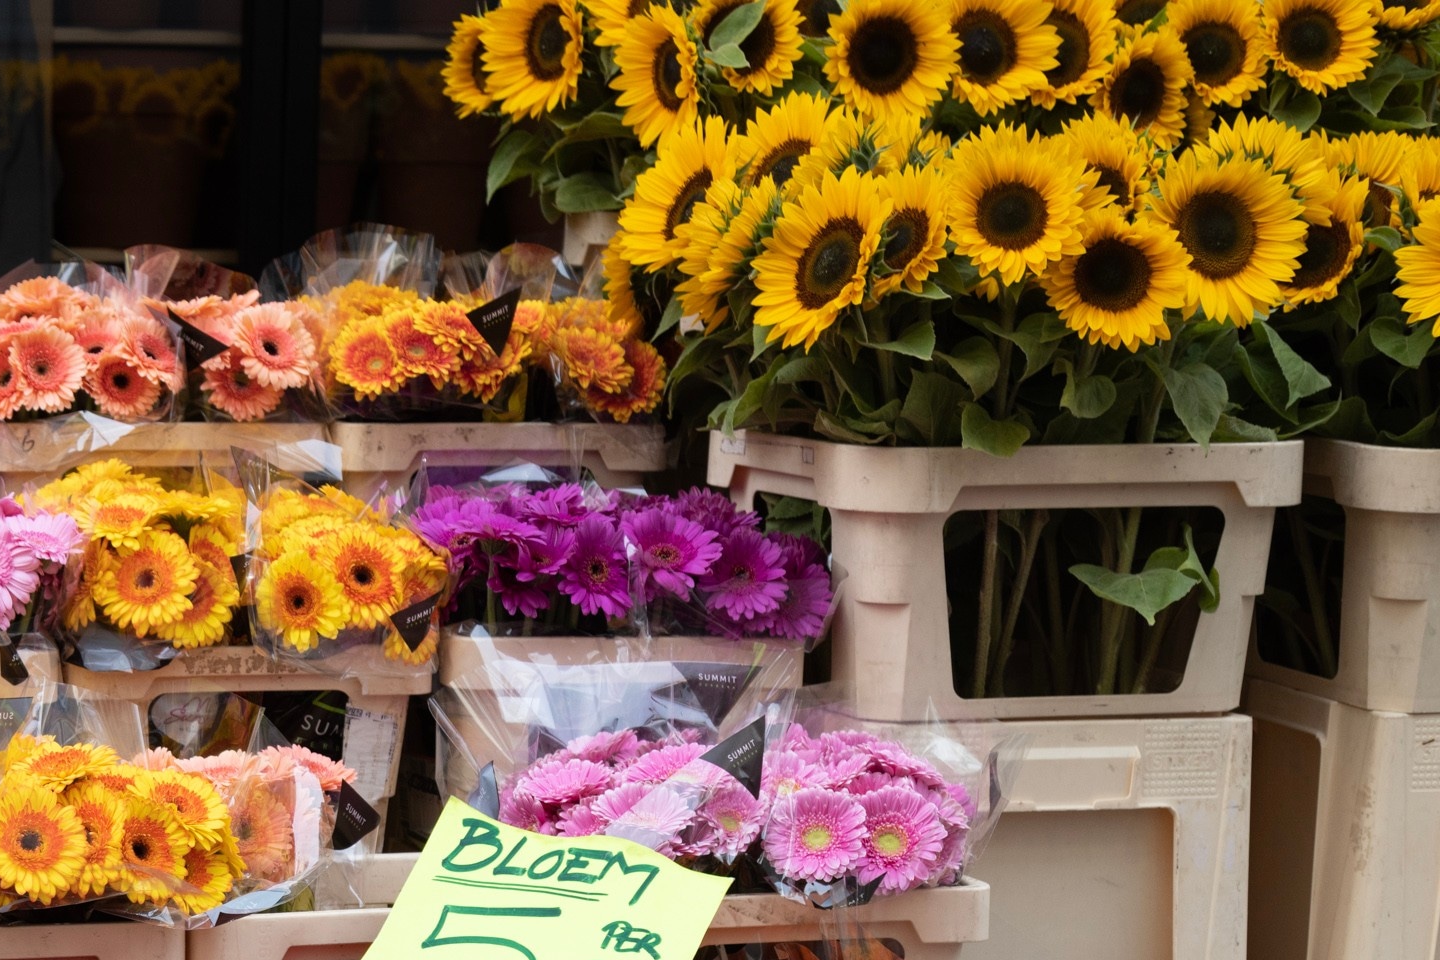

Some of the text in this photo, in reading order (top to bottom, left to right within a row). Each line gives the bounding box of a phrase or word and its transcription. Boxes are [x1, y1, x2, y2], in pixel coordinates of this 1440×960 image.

[482, 305, 509, 323] SUMMIT
[406, 605, 435, 625] SUMMIT
[698, 673, 737, 684] SUMMIT
[727, 739, 755, 762] SUMMIT
[345, 803, 366, 826] SUMMIT
[441, 816, 660, 906] BLOEM
[601, 920, 661, 960] PER
